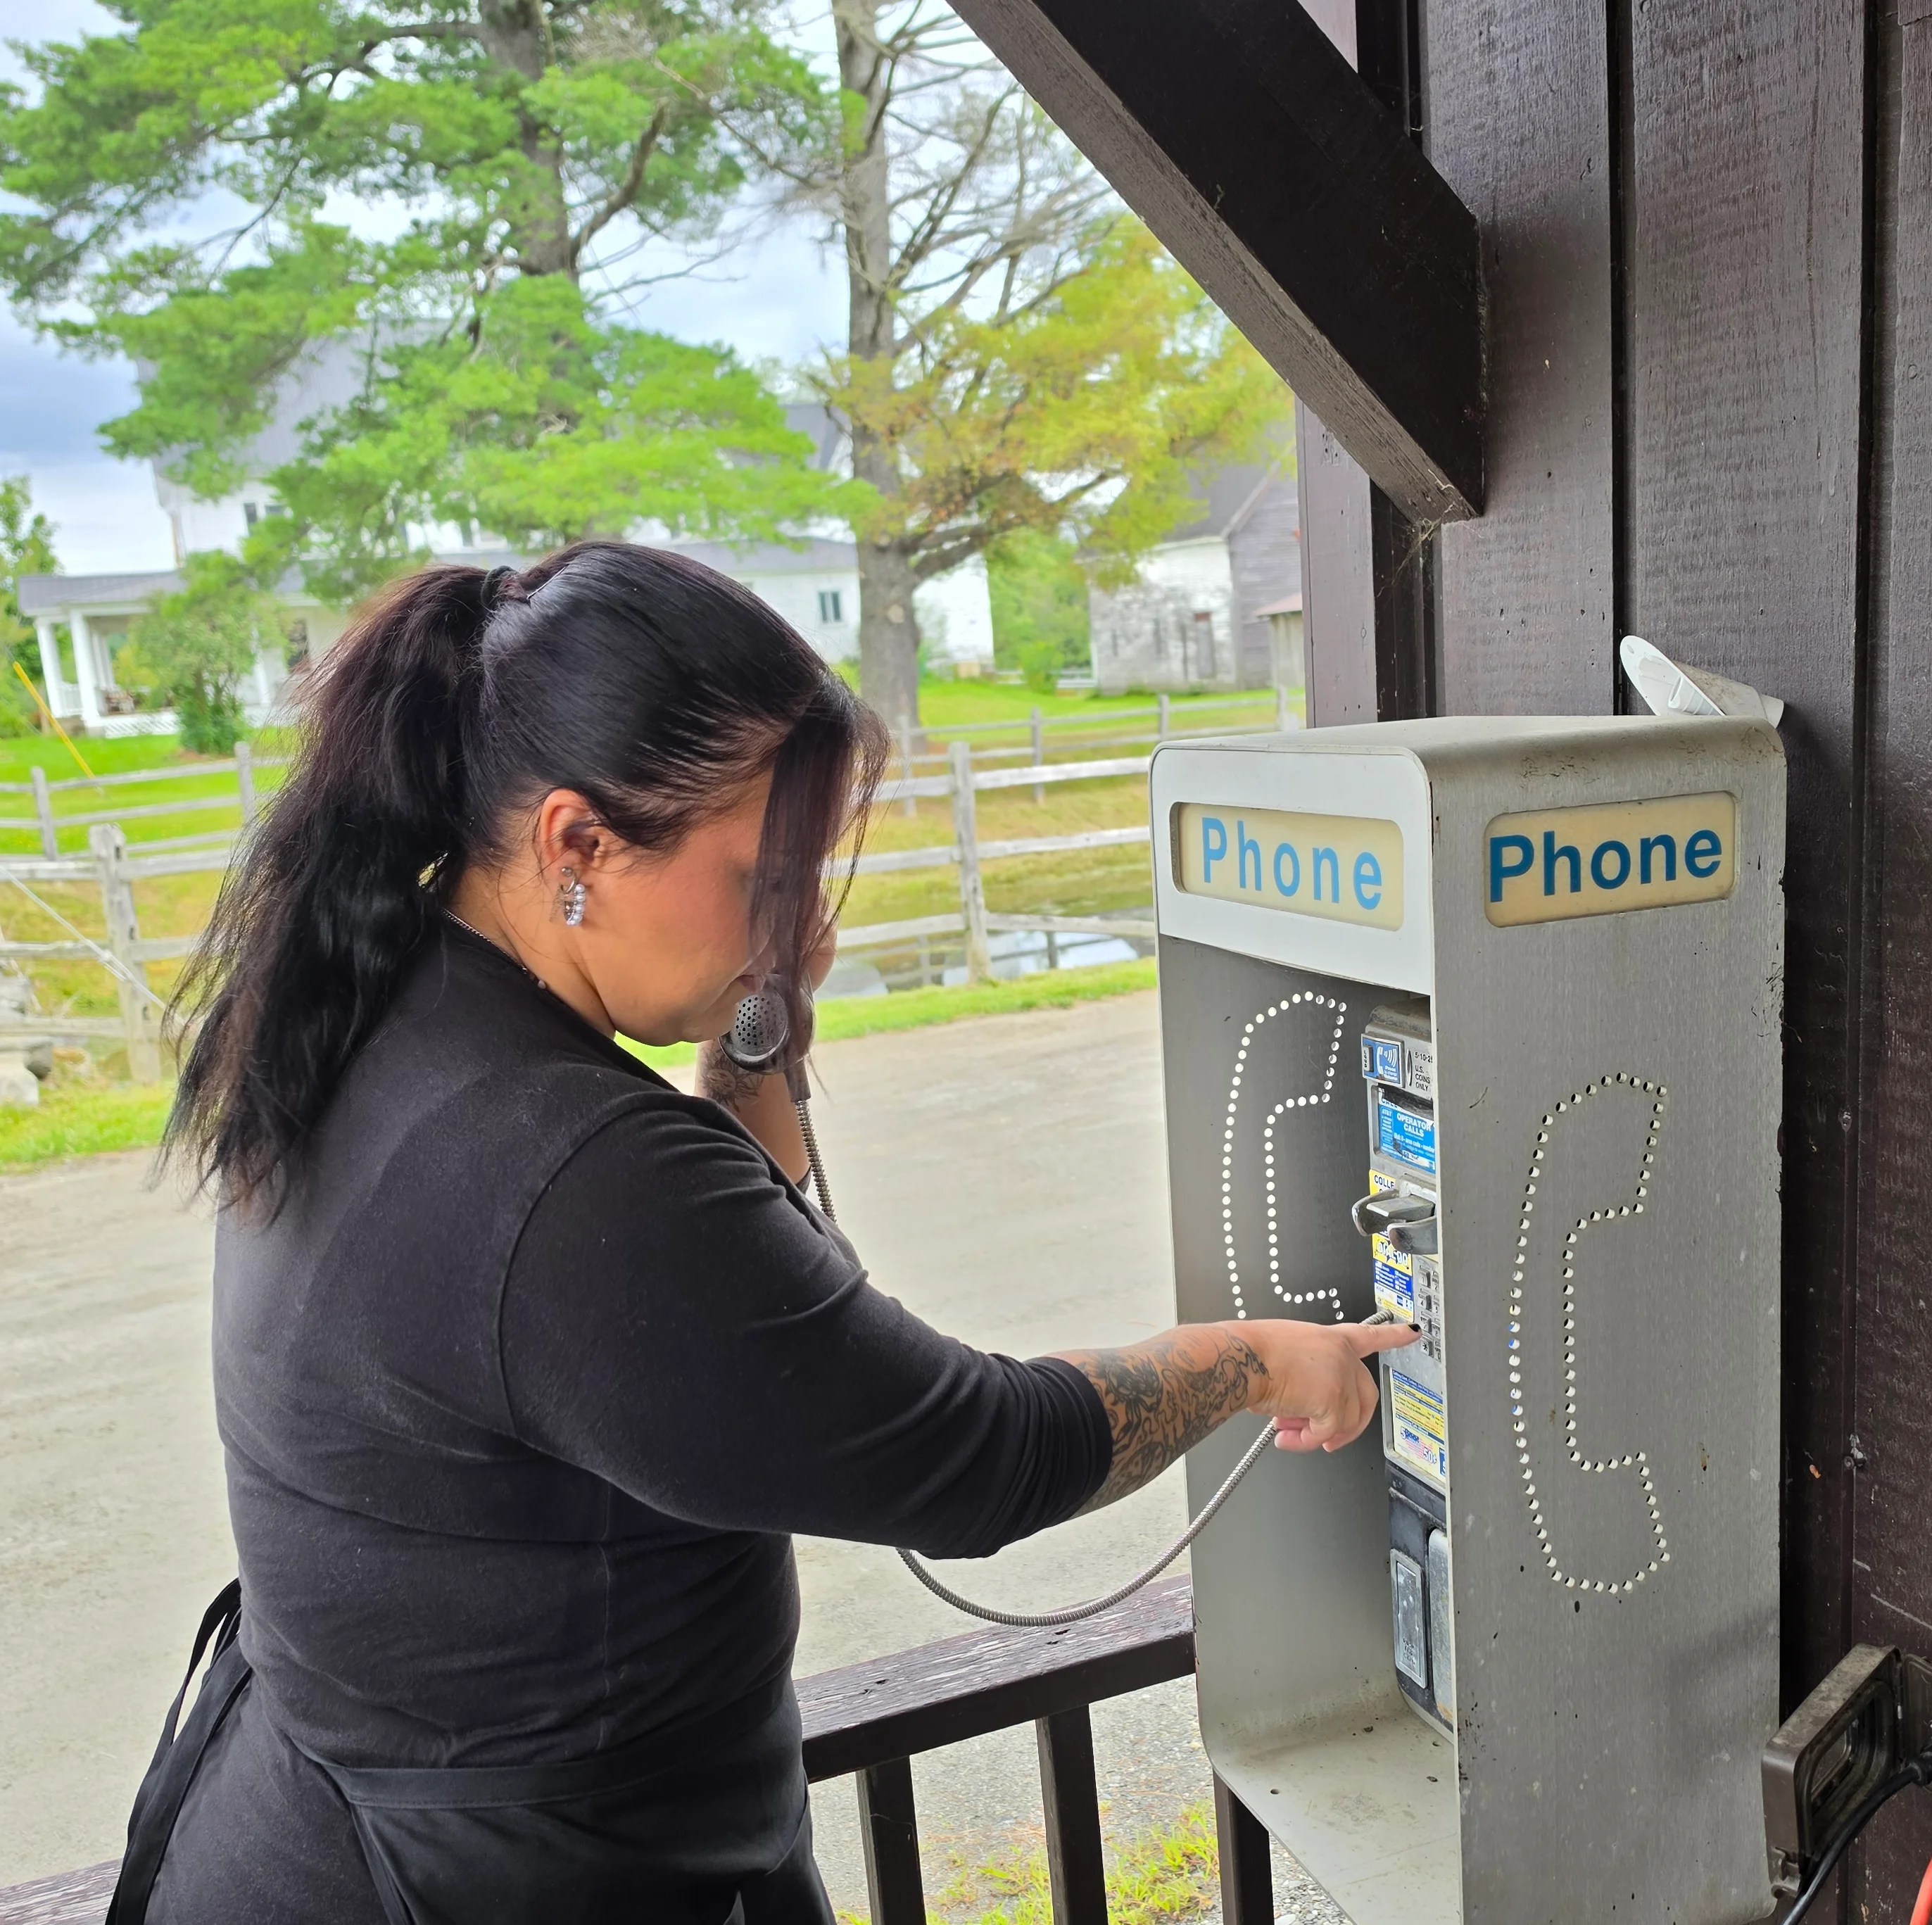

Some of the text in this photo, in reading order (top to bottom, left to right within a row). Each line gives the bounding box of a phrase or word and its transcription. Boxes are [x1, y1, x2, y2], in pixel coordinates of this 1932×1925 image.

[1201, 816, 1382, 911] Phone
[1489, 828, 1723, 903] Phone
[1415, 1065, 1425, 1073] U.S.
[1415, 1073, 1430, 1084] COINS
[1415, 1082, 1428, 1091] ONLY
[1396, 1112, 1432, 1132] OPERATOR
[1403, 1123, 1425, 1137] CALLS
